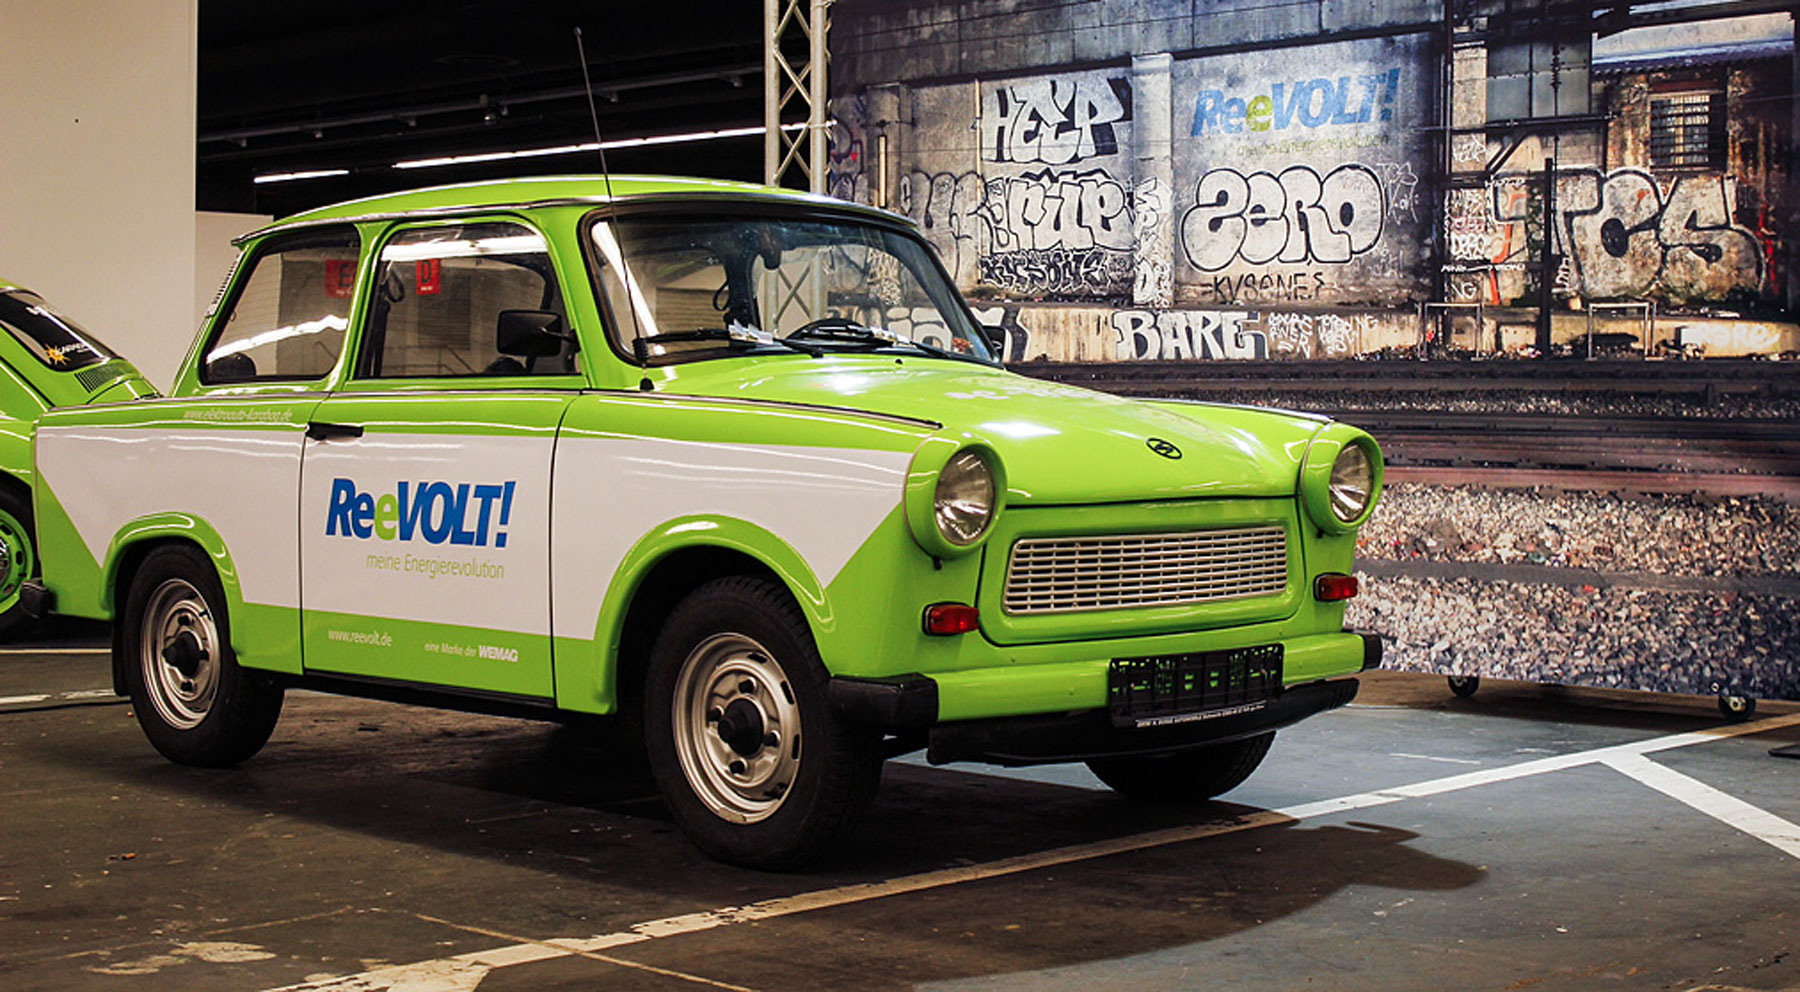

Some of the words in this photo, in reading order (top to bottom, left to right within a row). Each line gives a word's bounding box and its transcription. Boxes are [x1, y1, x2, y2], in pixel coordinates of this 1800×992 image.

[1191, 67, 1401, 137] ReeVOLT!
[420, 260, 431, 283] D
[326, 477, 516, 548] ReeVOLT!
[366, 551, 400, 571] meine
[404, 553, 505, 580] Energierevolution
[328, 629, 392, 647] www.reevolt.de
[424, 641, 440, 653] eine
[442, 642, 463, 657] Marke
[464, 645, 477, 658] der
[478, 644, 519, 663] WEMAG
